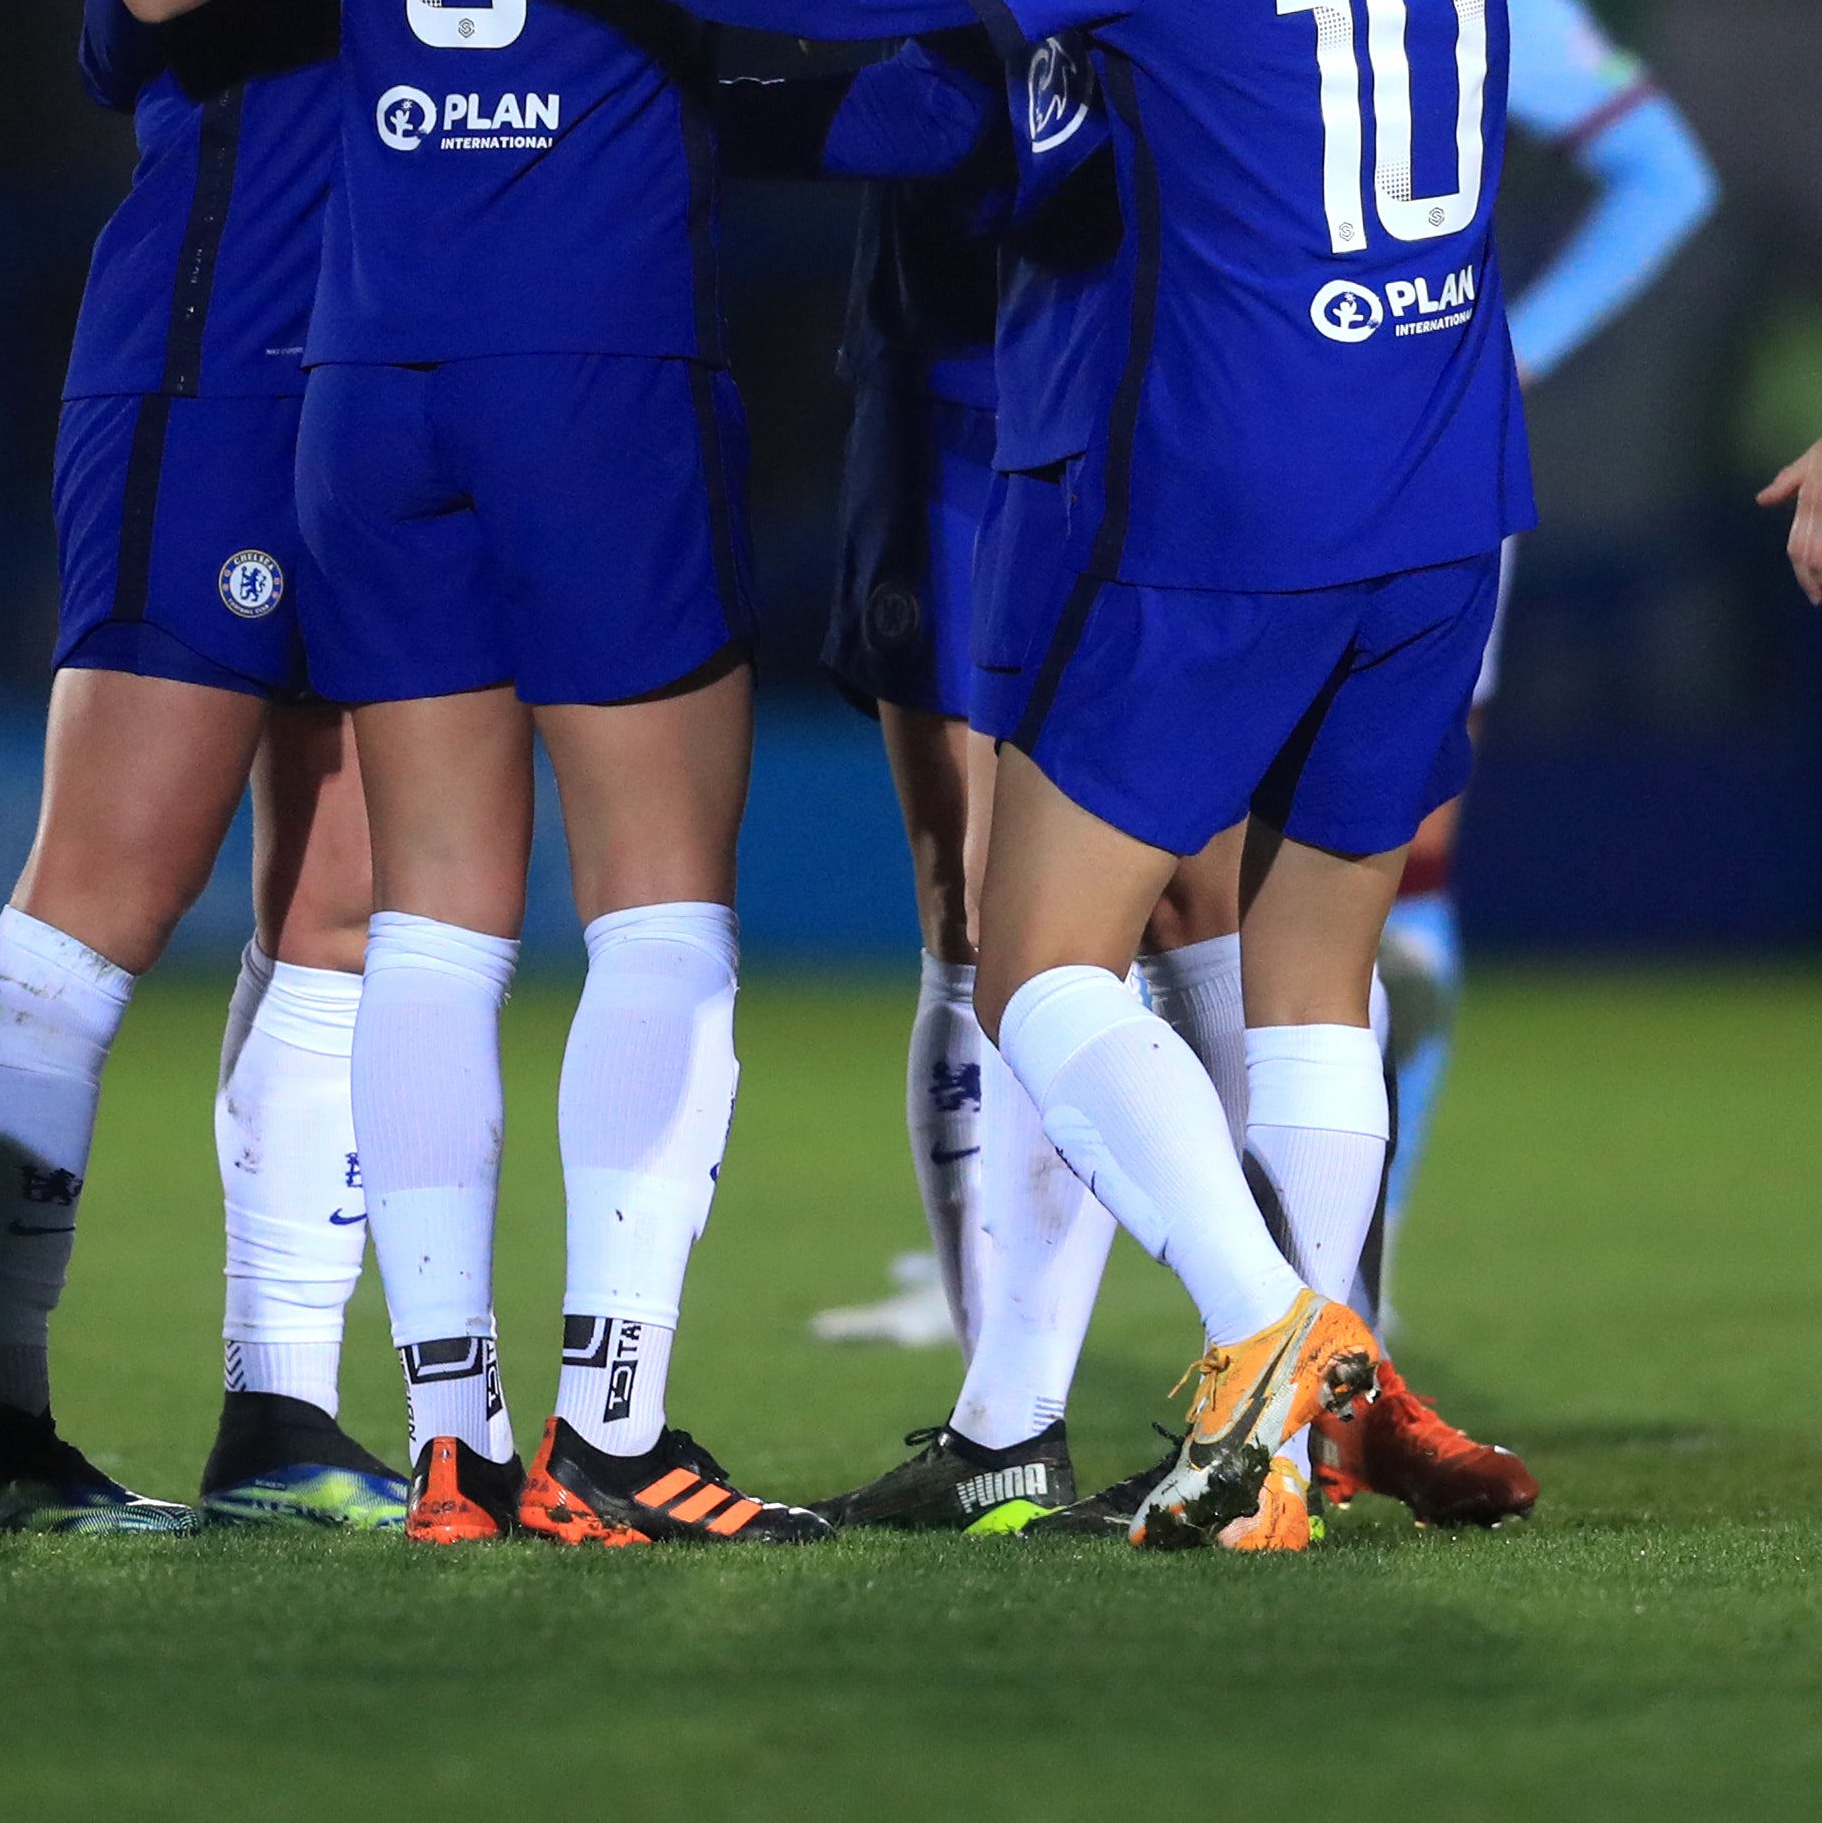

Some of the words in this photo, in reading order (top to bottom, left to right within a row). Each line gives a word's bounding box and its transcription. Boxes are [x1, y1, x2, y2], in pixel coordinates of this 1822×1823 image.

[442, 92, 560, 131] PLAN
[1384, 264, 1476, 317] PLAN
[234, 554, 274, 569] CHELSEA
[955, 1462, 1049, 1514] PUMA
